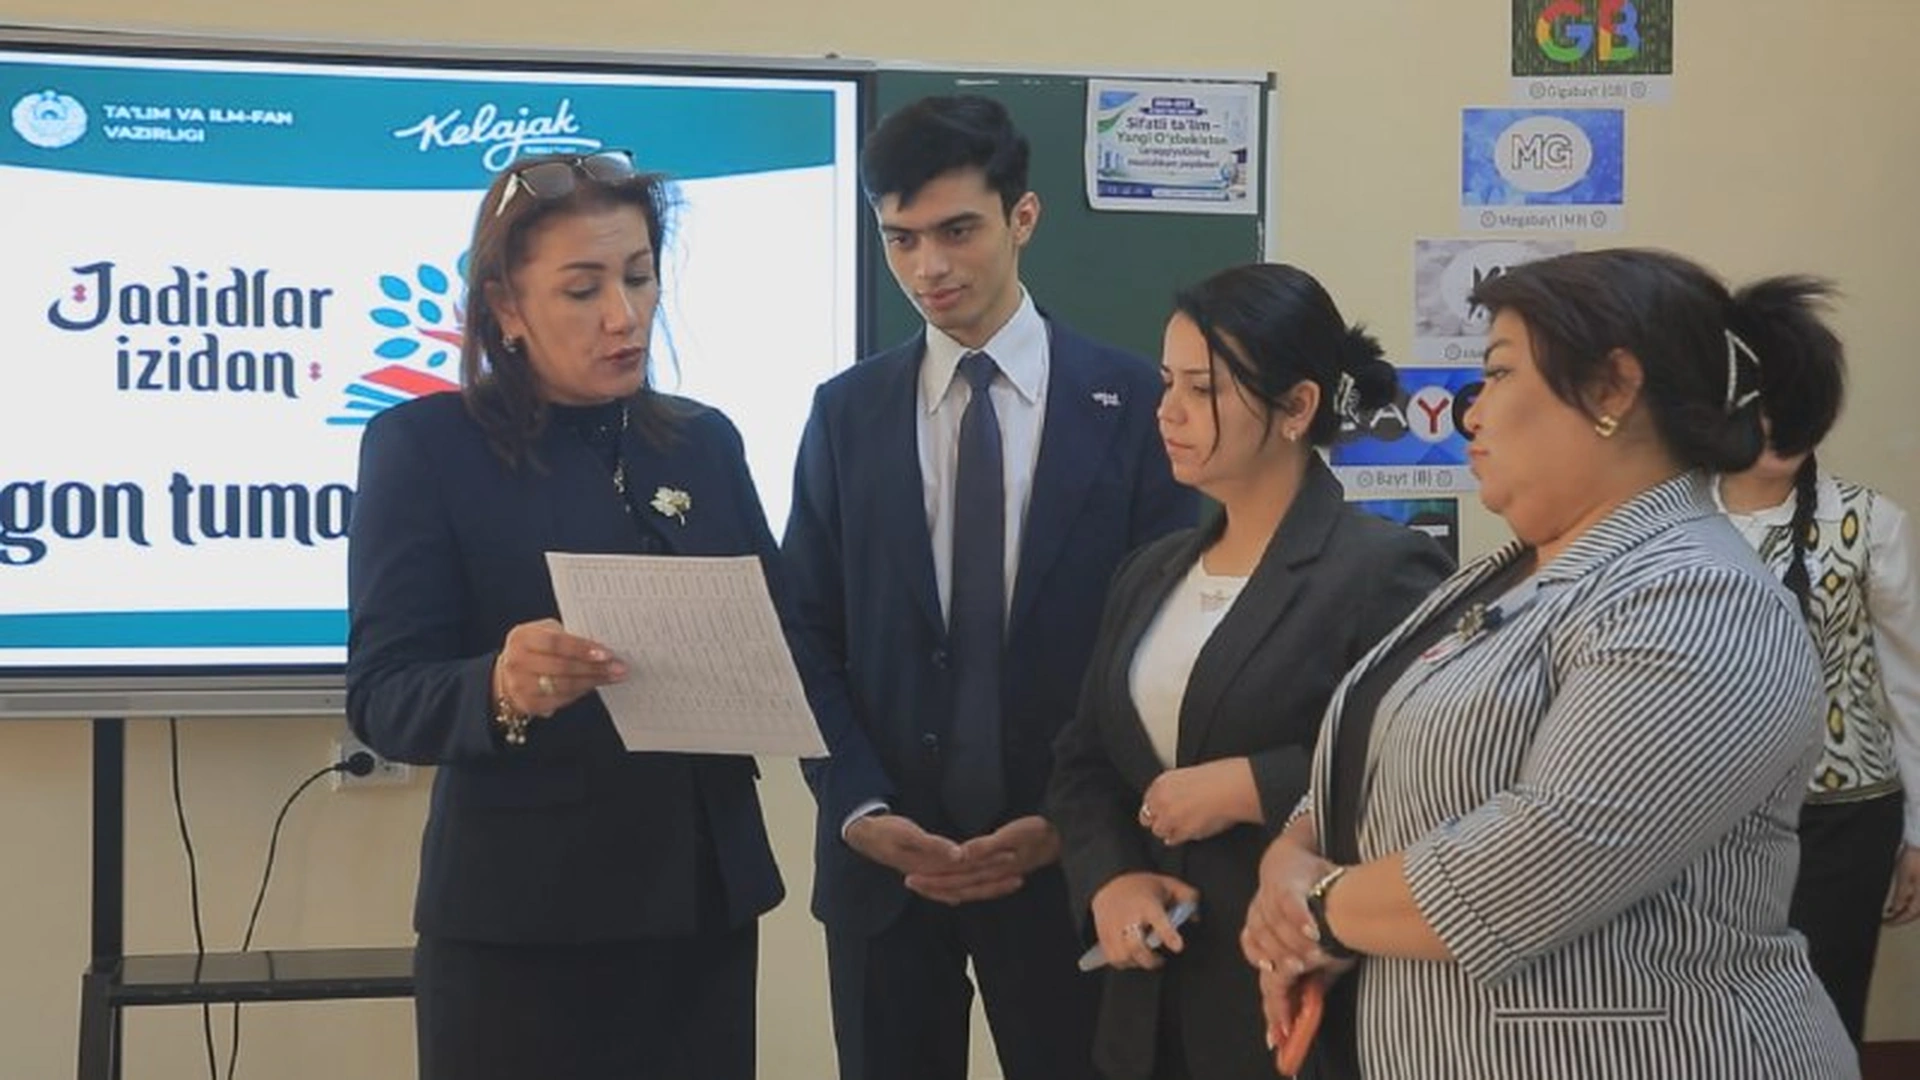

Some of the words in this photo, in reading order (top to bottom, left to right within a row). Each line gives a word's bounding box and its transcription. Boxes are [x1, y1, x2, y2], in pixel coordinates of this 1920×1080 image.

[1535, 0, 1641, 62] GB
[103, 124, 205, 142] VAZIRLIGI
[175, 107, 205, 122] VA
[209, 108, 293, 125] ILM-FAN
[393, 98, 602, 172] Kelajak
[1510, 133, 1574, 170] MG
[48, 261, 334, 331] Jadidlar
[116, 333, 300, 399] izidan
